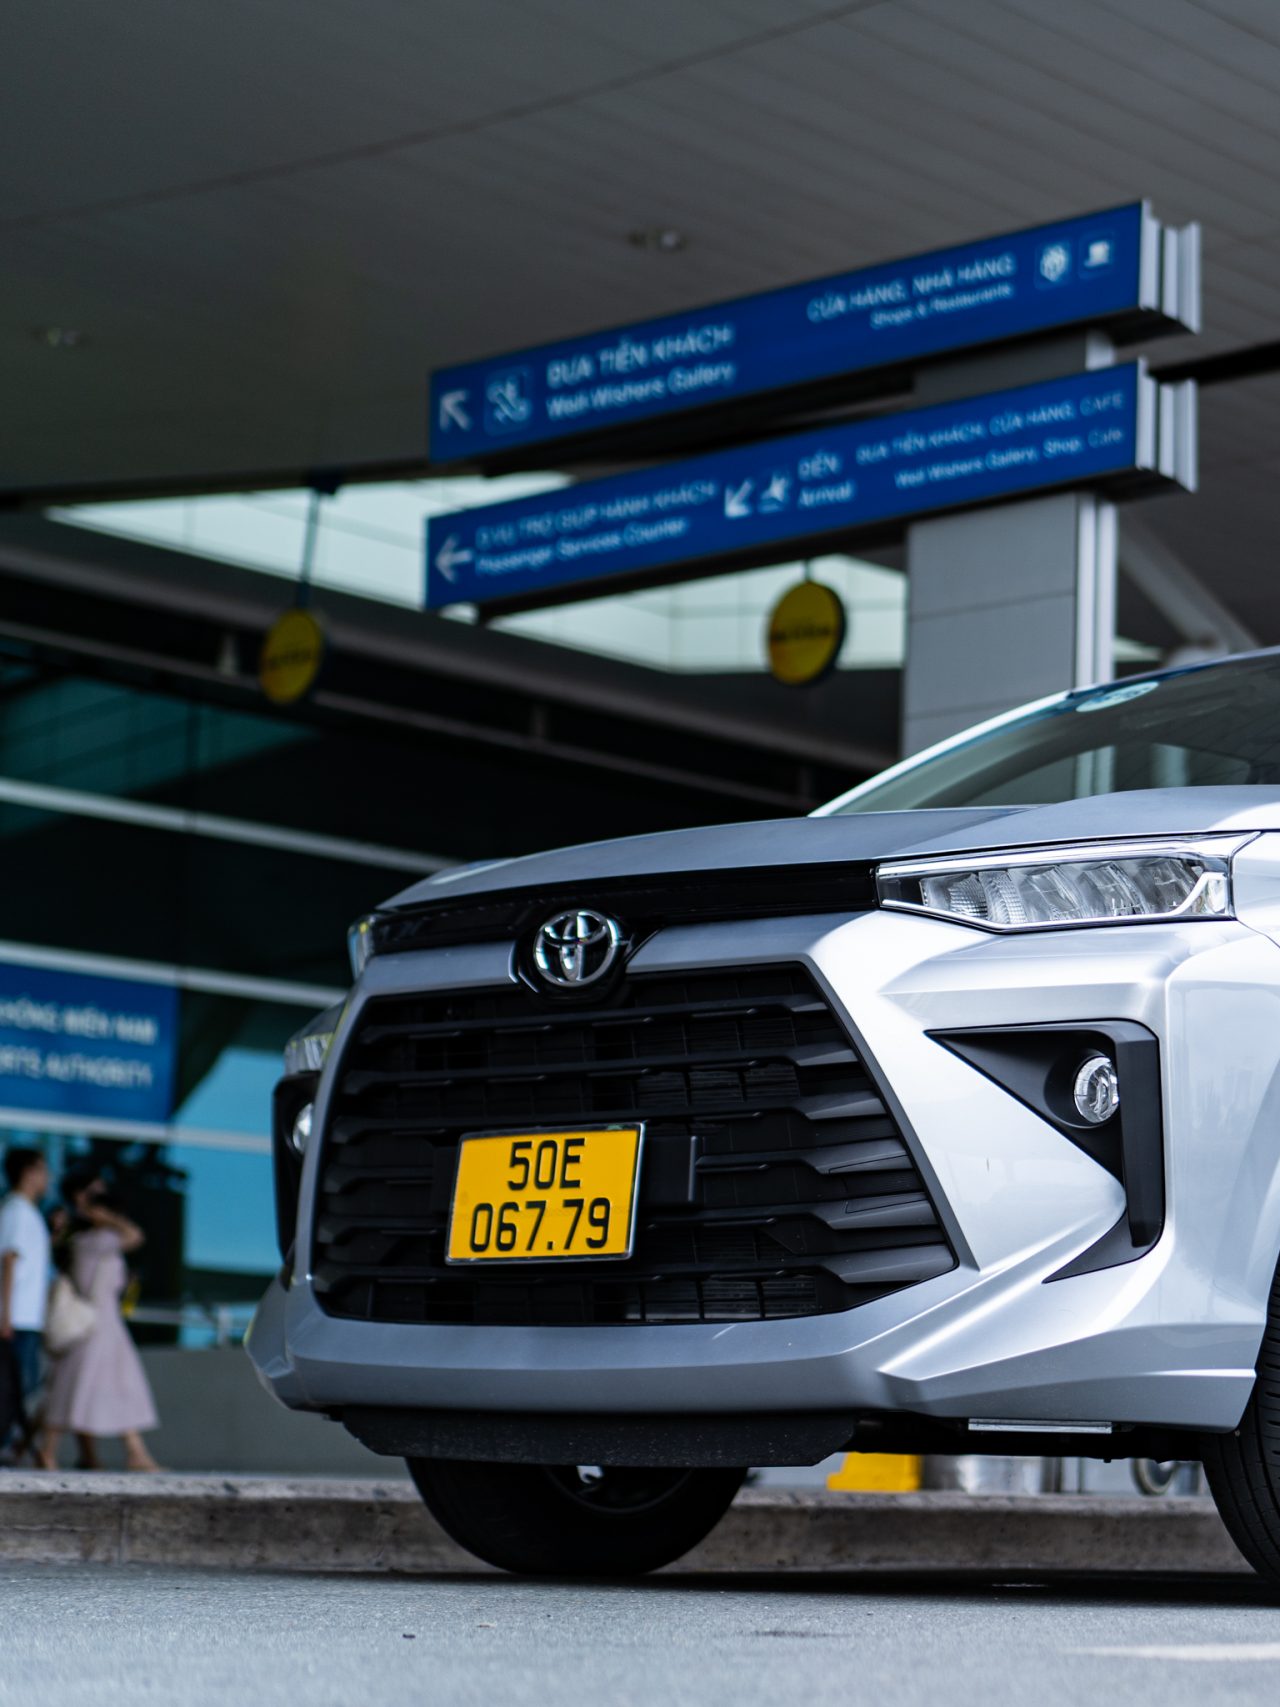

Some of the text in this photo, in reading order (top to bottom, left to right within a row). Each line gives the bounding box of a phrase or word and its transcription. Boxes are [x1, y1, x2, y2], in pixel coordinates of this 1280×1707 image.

[957, 254, 1016, 284] HÀNG
[651, 323, 736, 361] KHÁCH
[667, 360, 738, 396] Gallery
[476, 515, 691, 575] Passenger Services Counter
[507, 1137, 586, 1191] 50E
[470, 1197, 612, 1253] 067.79
